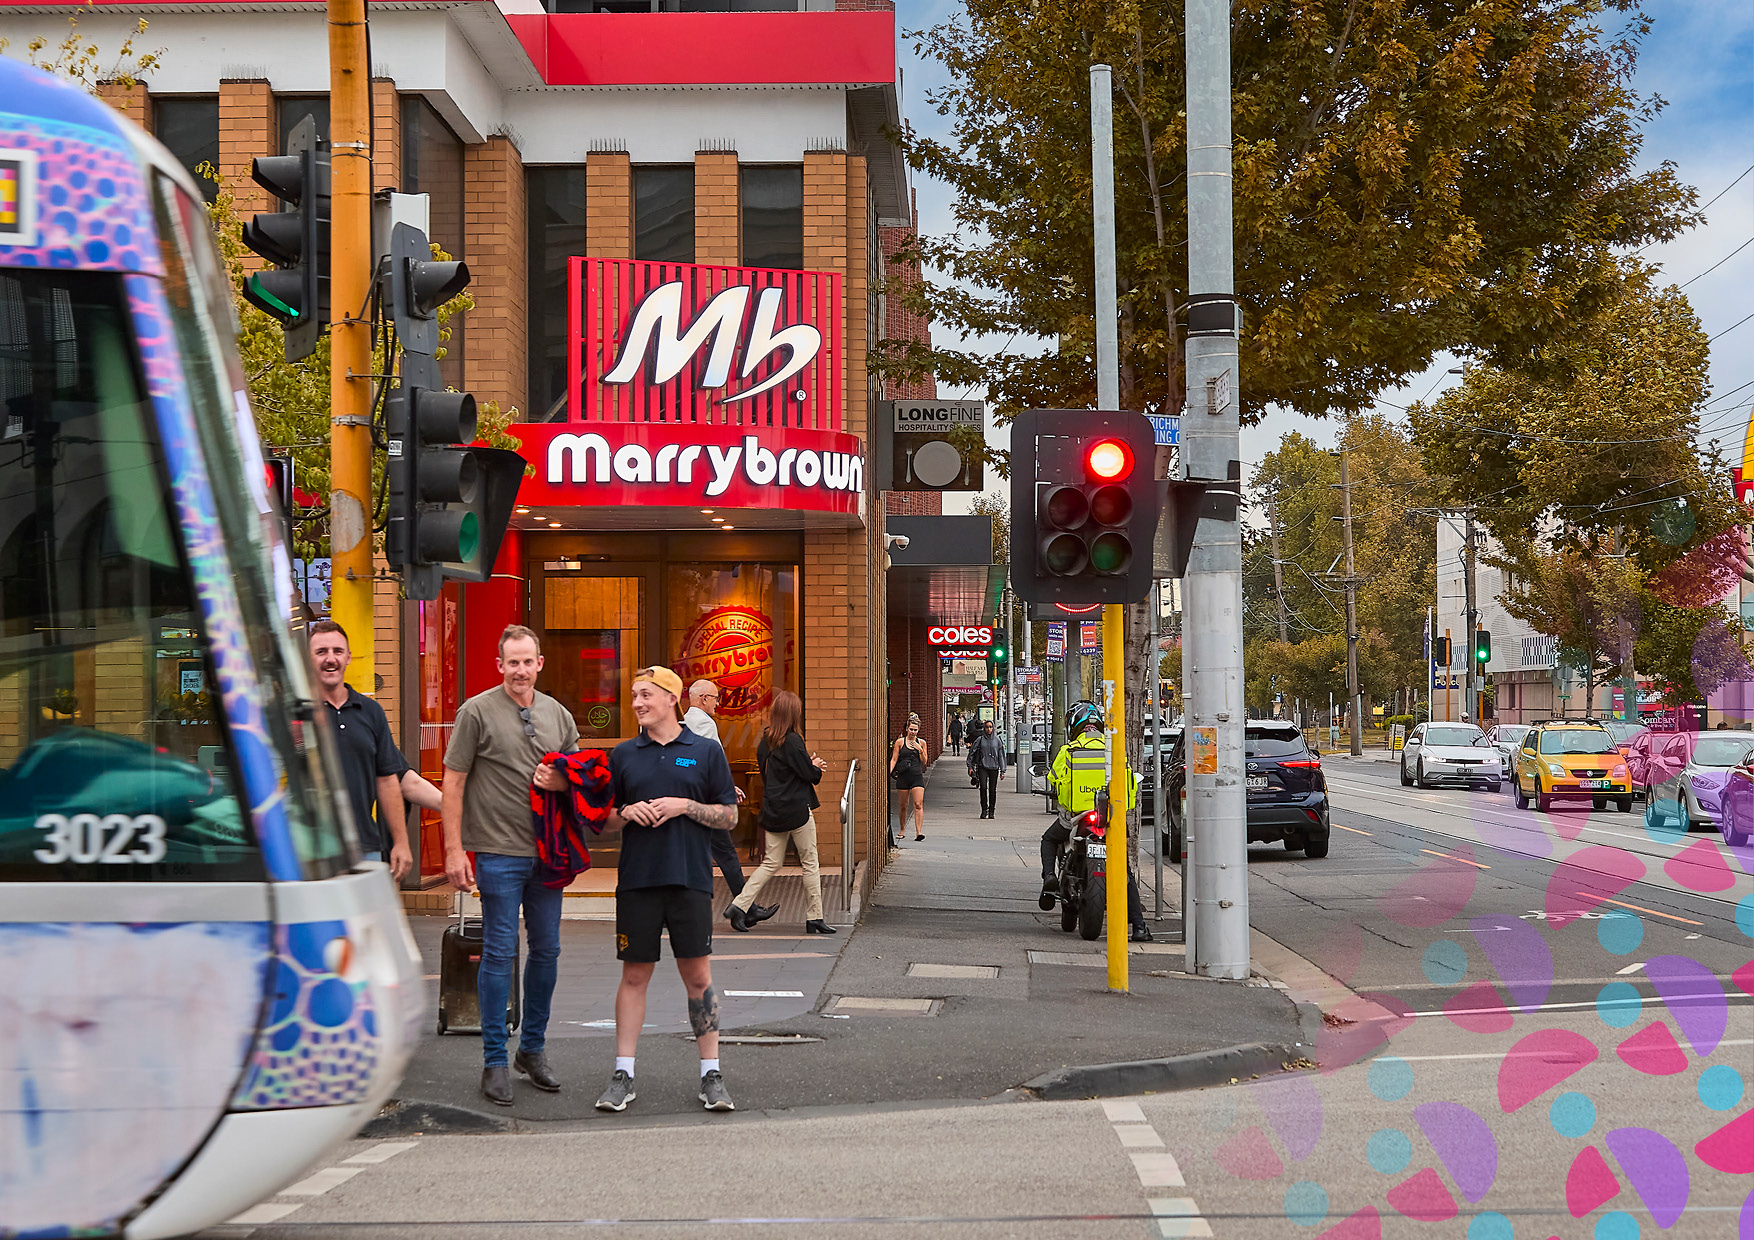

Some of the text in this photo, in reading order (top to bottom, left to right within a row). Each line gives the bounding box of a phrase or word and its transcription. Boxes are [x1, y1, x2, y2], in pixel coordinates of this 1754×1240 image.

[600, 280, 823, 404] Mb
[898, 424, 948, 432] HOSPITALITY
[694, 618, 763, 651] SPECIAL RECIPE
[928, 626, 992, 644] coles
[1603, 780, 1609, 788] P
[34, 813, 168, 865] 3023
